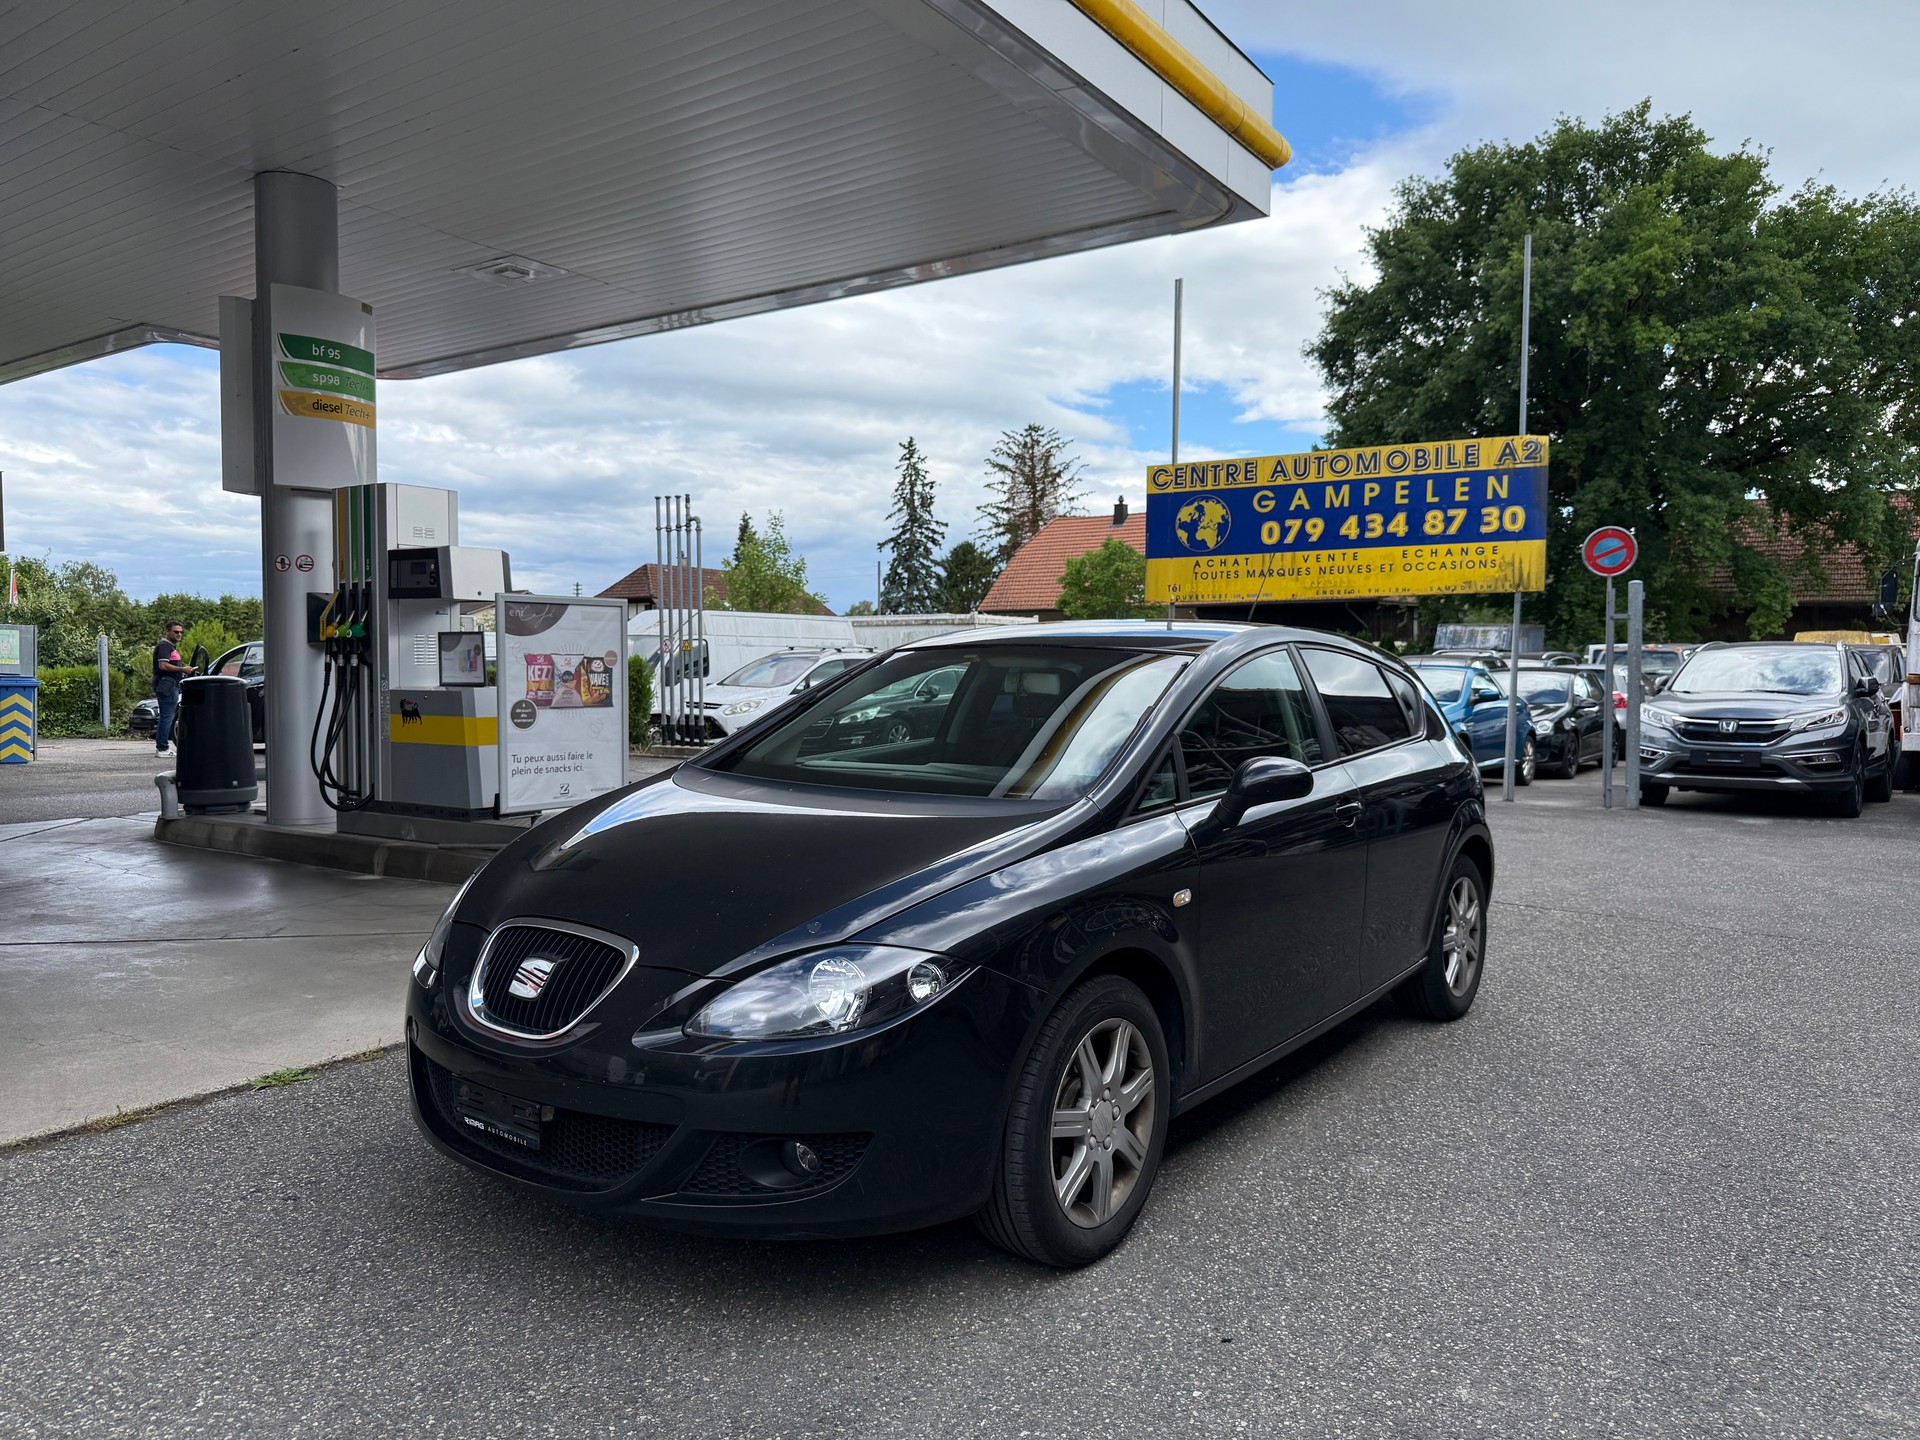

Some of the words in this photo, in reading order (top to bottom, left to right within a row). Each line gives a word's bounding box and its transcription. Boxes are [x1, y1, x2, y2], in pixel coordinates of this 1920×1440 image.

[312, 344, 325, 357] bf
[327, 348, 341, 360] 95
[312, 373, 340, 386] sp98
[312, 399, 343, 414] diesel
[345, 403, 371, 420] Tech+
[1152, 459, 1258, 490] CENTRE
[1267, 442, 1480, 482] AUTOMOBILE
[1494, 438, 1542, 466] A2
[1252, 474, 1510, 513] GAMPELEN
[1260, 518, 1324, 545] 079
[1339, 511, 1409, 540] 434
[1422, 508, 1468, 536] 87
[1479, 505, 1526, 534] 30
[1193, 557, 1250, 569] ACHAT
[1302, 552, 1359, 564] VENTE
[1402, 545, 1500, 559] ECHANGE
[429, 571, 437, 586] 5
[1193, 570, 1240, 581] TOUTES
[1246, 567, 1311, 579] MARQUES
[1318, 563, 1372, 576] NEUVES
[1380, 563, 1395, 573] ET
[1402, 559, 1498, 572] OCCASIONS
[1167, 584, 1181, 592] Tél
[509, 607, 524, 617] eni
[512, 754, 522, 763] Tu
[524, 755, 545, 764] peux
[546, 752, 566, 762] aussi
[567, 751, 585, 760] faire
[586, 751, 593, 759] le
[511, 766, 532, 777] plein
[533, 766, 543, 774] de
[545, 764, 572, 774] snacks
[573, 763, 584, 772] ici.
[487, 1126, 527, 1146] AUTOMOBILE
